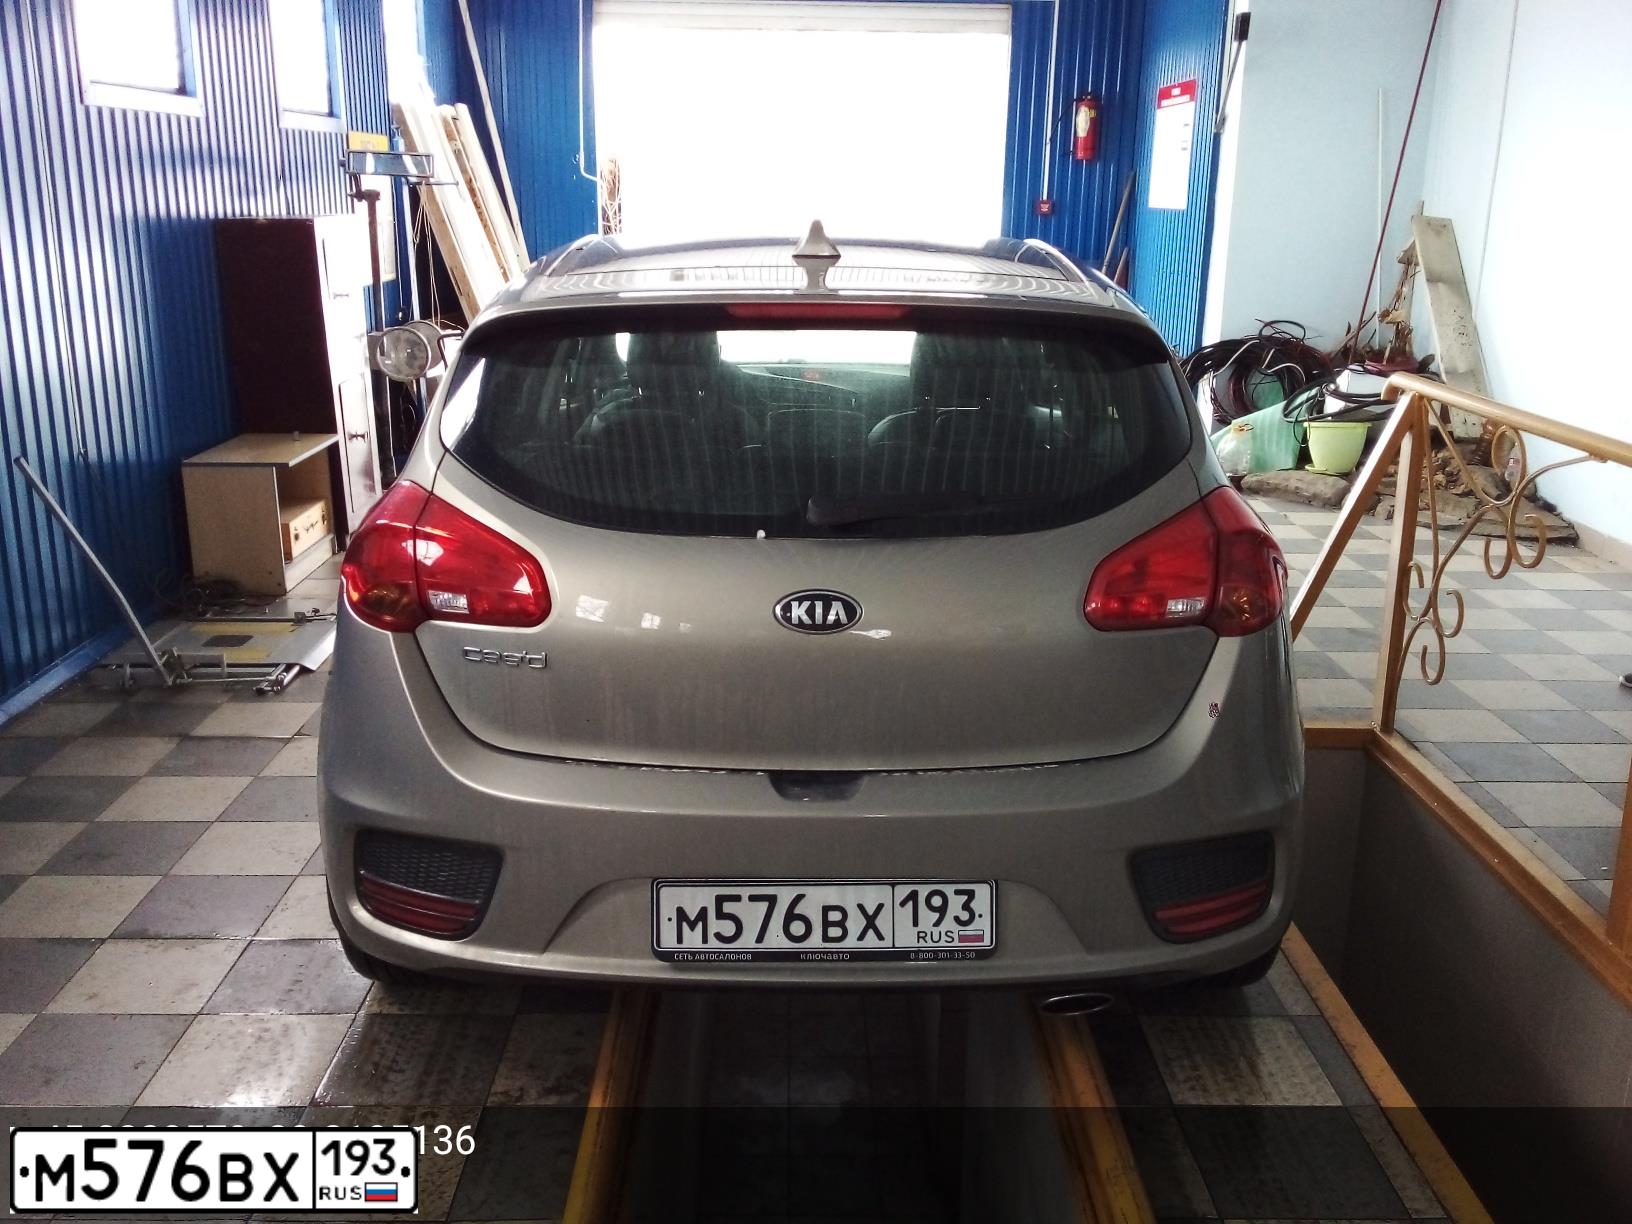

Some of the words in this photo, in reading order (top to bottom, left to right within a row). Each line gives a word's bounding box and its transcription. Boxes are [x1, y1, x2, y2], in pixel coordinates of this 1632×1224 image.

[791, 599, 849, 625] KIA
[898, 888, 977, 928] 193
[916, 930, 955, 944] RUS
[674, 952, 693, 961] СЕТЬ
[694, 952, 752, 961] АВТОСАЛОНОВ
